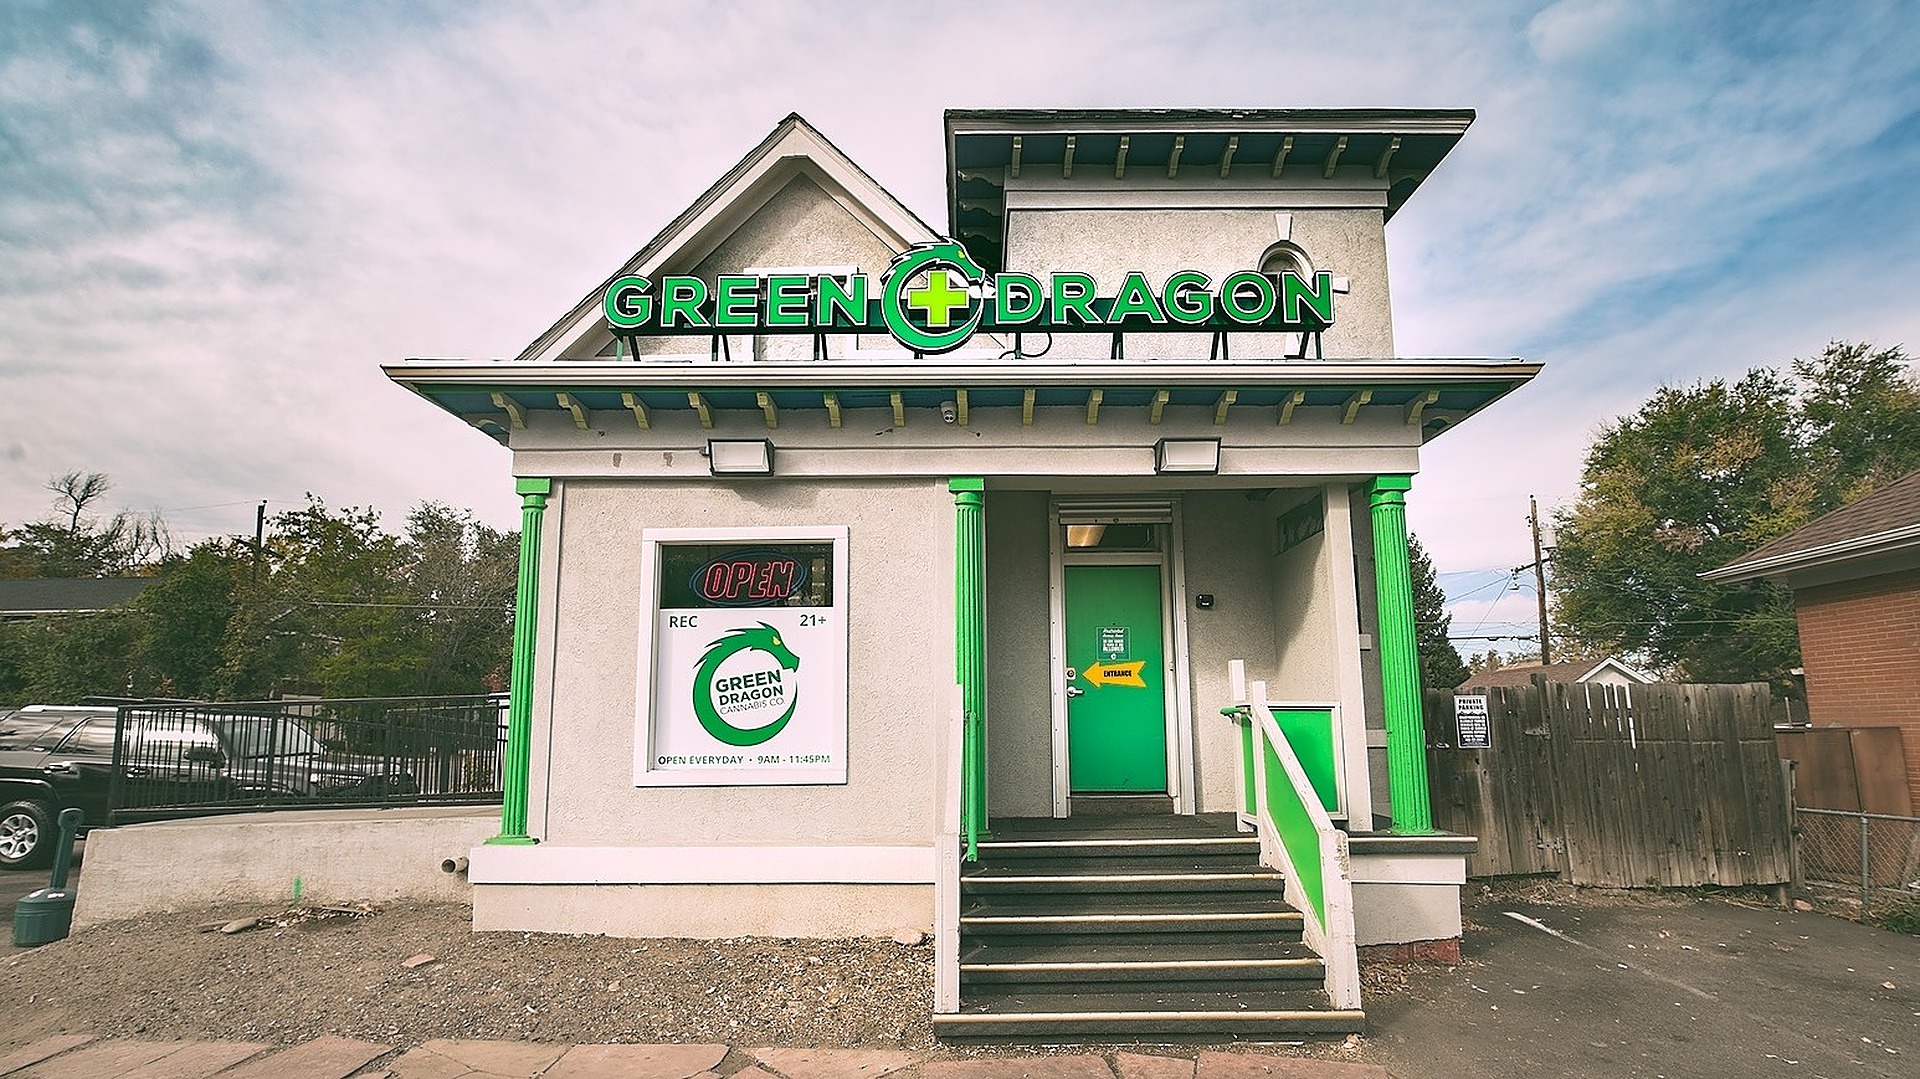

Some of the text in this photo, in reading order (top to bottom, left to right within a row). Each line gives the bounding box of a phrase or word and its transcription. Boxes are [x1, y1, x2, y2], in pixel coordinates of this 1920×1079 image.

[603, 270, 1336, 329] GREEN DRAGON
[703, 561, 795, 599] OPEN
[669, 615, 698, 628] REC
[799, 613, 827, 627] 21+
[715, 669, 782, 693] GREEN
[1103, 669, 1132, 678] ENTRANCE
[718, 684, 784, 706] DRAGON
[719, 698, 768, 715] CANNABIS
[657, 755, 686, 765] OPEN
[688, 755, 744, 765] EVERYDAY
[757, 754, 780, 764] 9AM
[789, 754, 831, 764] 11:45PM
